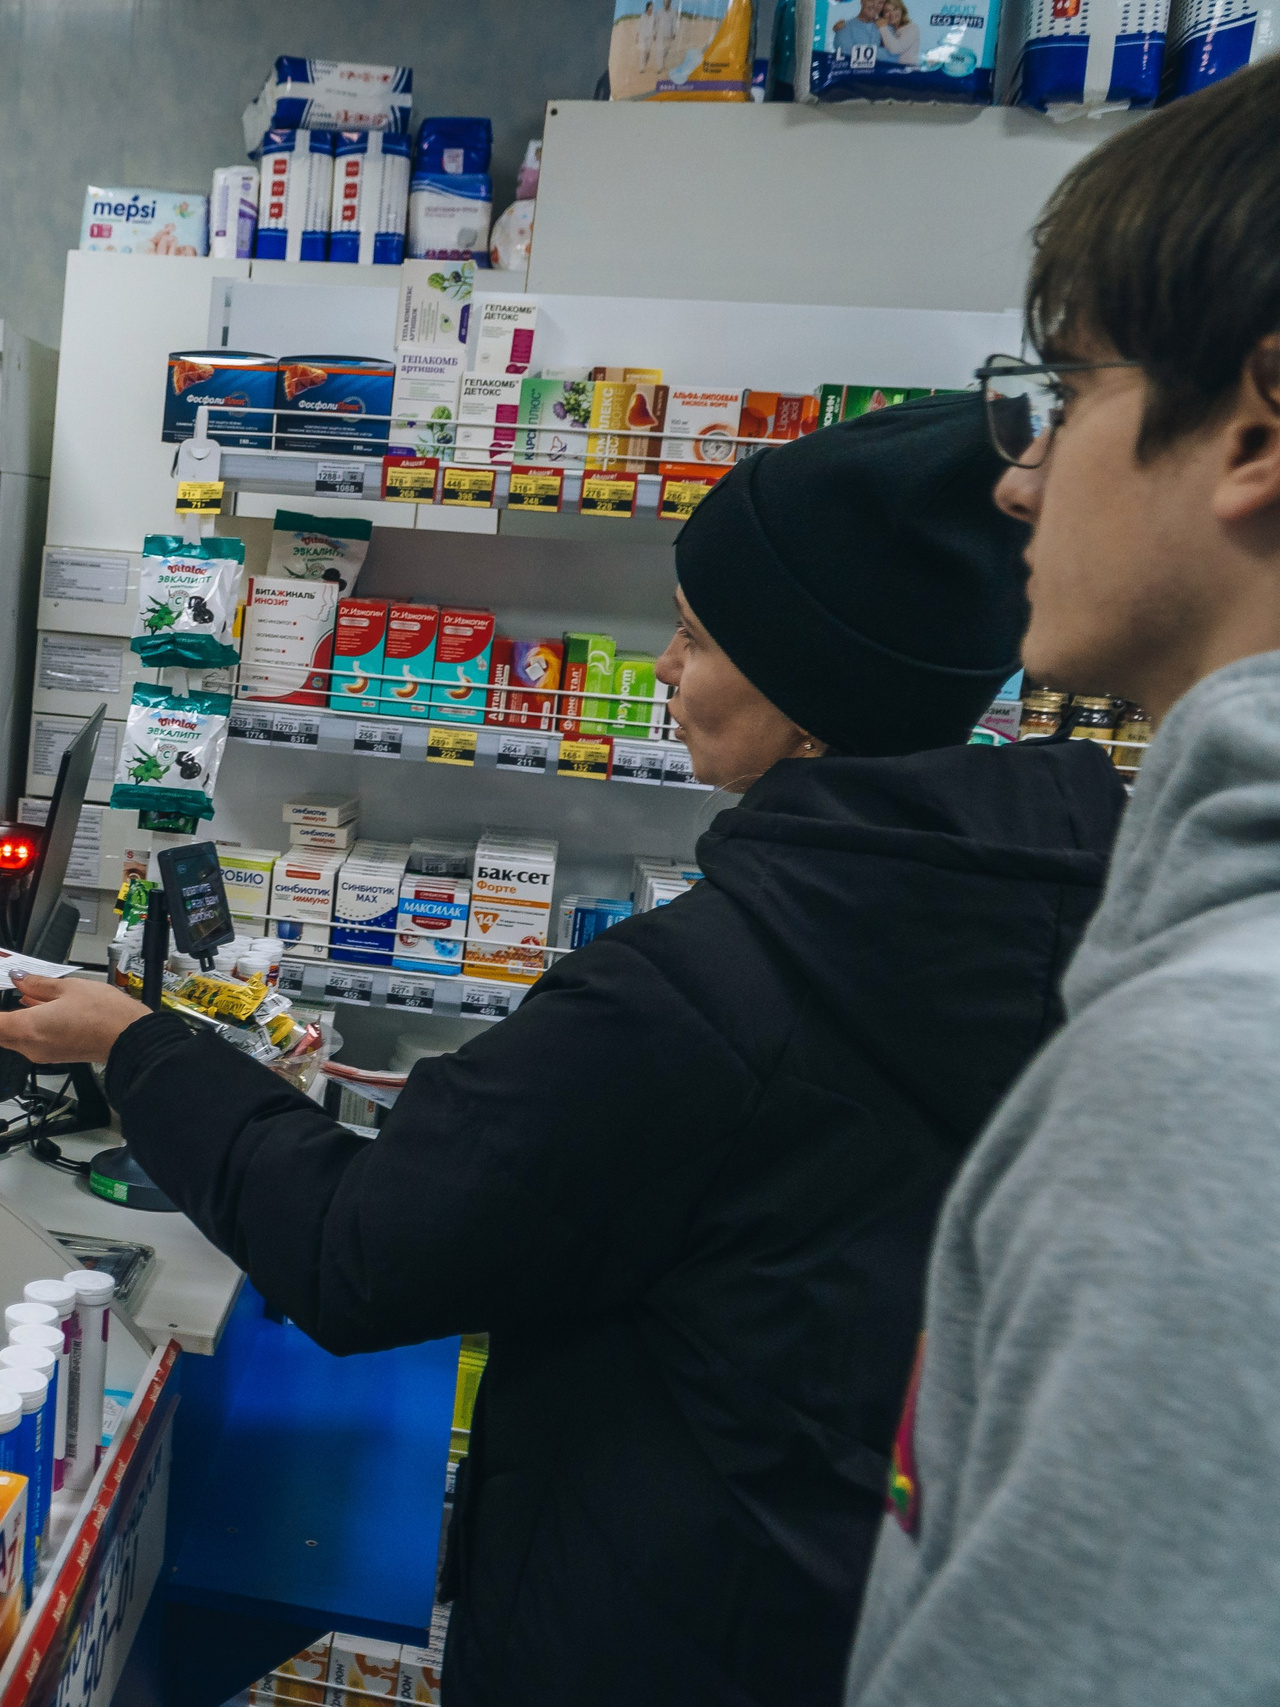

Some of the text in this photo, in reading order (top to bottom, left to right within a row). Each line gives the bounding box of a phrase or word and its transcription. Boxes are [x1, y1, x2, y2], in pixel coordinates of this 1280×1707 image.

[931, 16, 950, 26] ECO
[855, 47, 874, 60] 10
[93, 195, 156, 222] mepsi
[485, 304, 532, 314] ГЕПАКОМБ
[484, 312, 519, 322] ДЕТОКС
[402, 354, 459, 366] ГЕПАКОМБ
[401, 364, 446, 374] артишок
[464, 378, 516, 389] ГЕПАКОМБ
[464, 386, 502, 397] ДЕТОКС
[672, 390, 740, 403] АЛЬФА-ЛИПОЕВАЯ
[400, 458, 427, 468] Акция!
[319, 472, 338, 481] 1288
[527, 468, 555, 478] Акция!
[591, 472, 618, 481] Акция!
[389, 477, 404, 487] 378
[181, 490, 192, 498] 91
[585, 488, 601, 498] 278
[191, 500, 202, 509] 71
[157, 574, 213, 584] ЭВКАЛИПТ
[255, 587, 315, 600] ВИТАЖИНАЛЬ
[254, 597, 289, 607] ИНОЗИТ
[339, 606, 384, 618] Dr.Изжогин
[390, 609, 437, 622] Dr.Изжогин
[444, 614, 491, 627] Dr.Изжогин
[228, 718, 248, 728] 2539
[274, 722, 294, 732] 1270
[146, 727, 203, 741] ЭВКАЛИПТ
[245, 731, 264, 740] 1774
[290, 734, 305, 743] 831
[429, 737, 446, 747] 289
[373, 743, 389, 752] 204
[502, 745, 517, 754] 264
[440, 749, 457, 759] 225
[517, 758, 532, 767] 211
[572, 763, 589, 773] 132
[291, 807, 328, 817] синбиотик
[299, 828, 336, 838] синбиотик
[220, 868, 264, 886] РОБИО
[274, 883, 331, 897] синбиотик
[340, 881, 395, 896] СИНБИОТИК
[476, 879, 517, 895] Форте
[292, 895, 330, 906] иммуно
[355, 892, 379, 904] MAX
[403, 901, 464, 918] МАКСИЛАК
[477, 912, 494, 927] 14
[329, 977, 345, 986] 567
[342, 990, 360, 1000] 452
[405, 998, 420, 1007] 567
